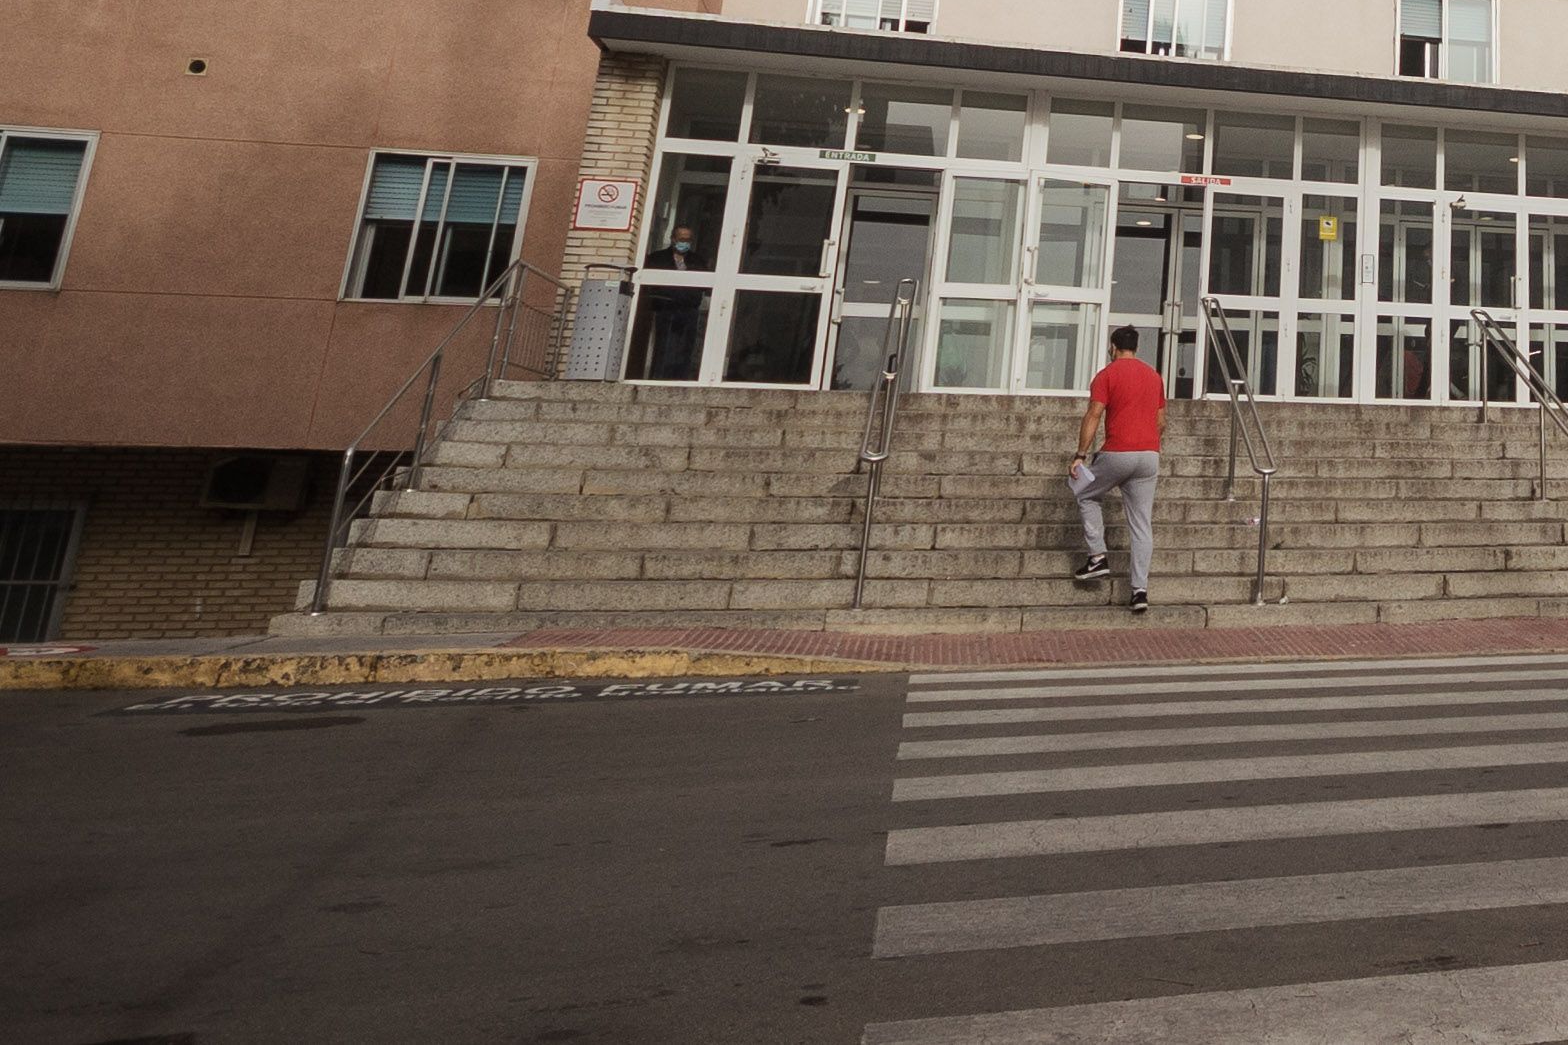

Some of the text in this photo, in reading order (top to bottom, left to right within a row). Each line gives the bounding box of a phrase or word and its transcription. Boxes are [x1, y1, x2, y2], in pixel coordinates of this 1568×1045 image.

[825, 151, 870, 161] ENTRADA
[1190, 176, 1221, 185] SALIDA
[165, 680, 834, 704] PROHIBIDO FUMAR
